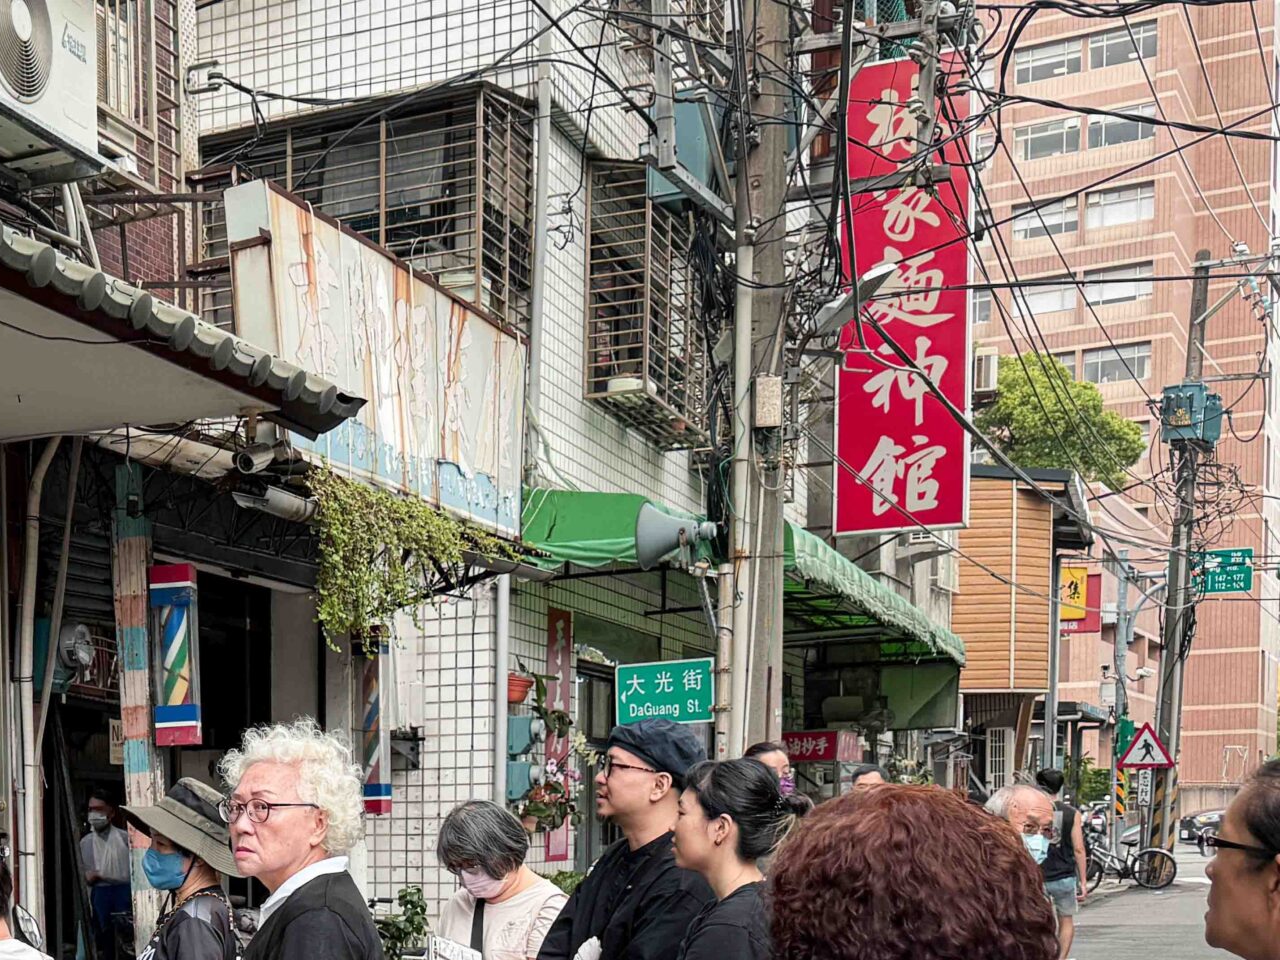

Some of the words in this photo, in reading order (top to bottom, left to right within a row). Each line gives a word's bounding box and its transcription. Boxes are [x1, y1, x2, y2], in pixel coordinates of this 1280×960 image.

[626, 669, 703, 696] 大光街
[629, 702, 680, 717] DaGuang
[687, 699, 702, 713] St.
